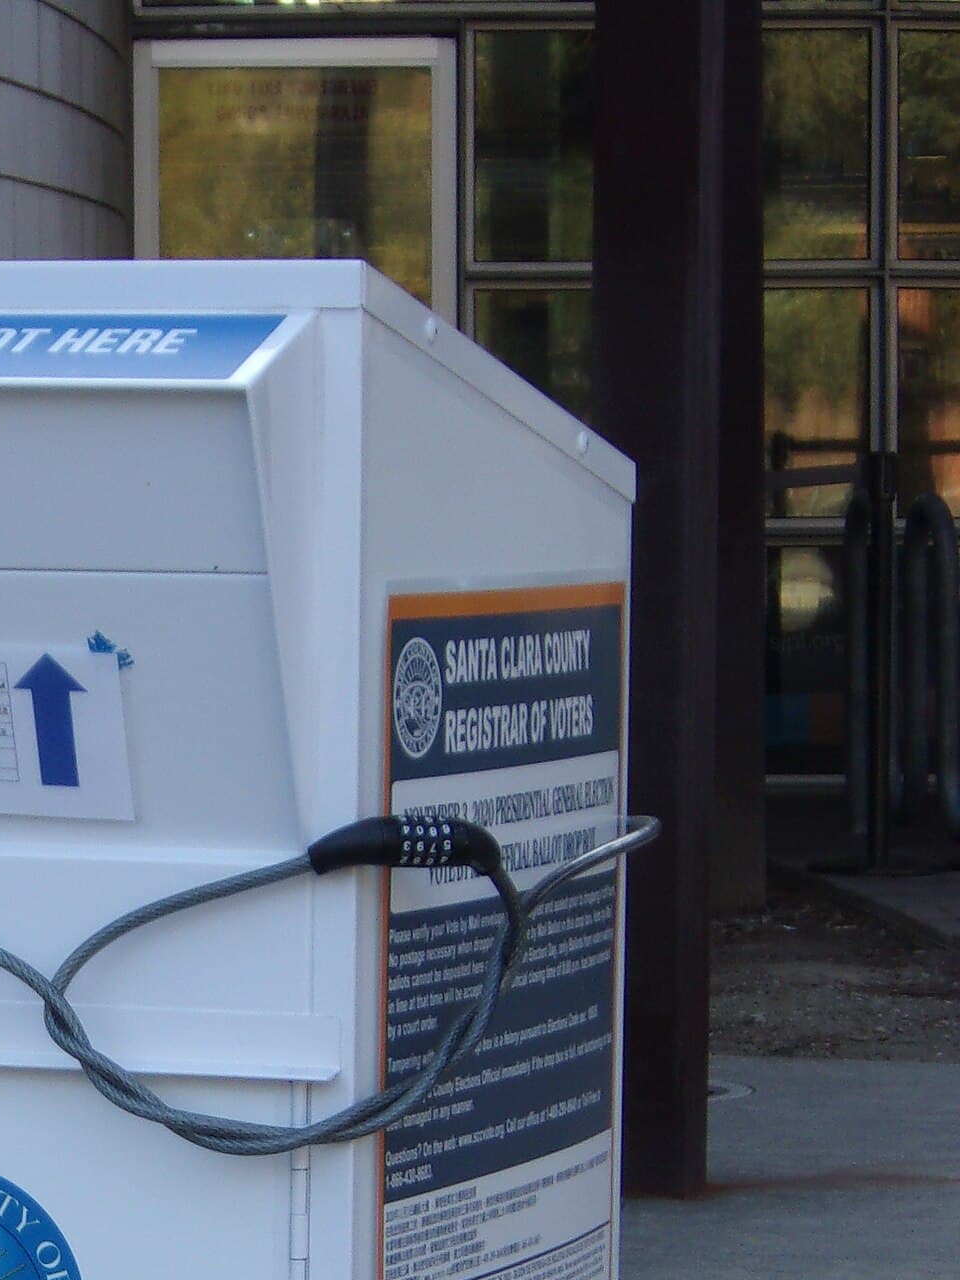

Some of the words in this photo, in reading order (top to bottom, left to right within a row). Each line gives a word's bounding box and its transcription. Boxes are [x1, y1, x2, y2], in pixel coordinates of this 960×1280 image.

[48, 328, 198, 355] HERE
[445, 638, 498, 684] SANTA
[501, 633, 541, 679] CLARA
[544, 629, 591, 674] COUNTY
[445, 702, 528, 754] REGISTRAR
[531, 701, 547, 743] OF
[549, 694, 593, 740] VOTERS
[495, 787, 553, 826] PRESIDENTIAL
[533, 833, 562, 869] BALLOT
[389, 929, 410, 943] Please
[446, 920, 458, 933] Vote
[459, 918, 467, 934] by
[389, 953, 398, 966] No
[399, 951, 424, 966] postage
[426, 945, 455, 959] necessary
[388, 976, 409, 990] ballots
[411, 972, 432, 985] cannot
[434, 969, 441, 981] be
[387, 1025, 395, 1039] by
[402, 1020, 419, 1034] court
[388, 1056, 420, 1072] Tampering
[433, 1081, 453, 1096] County
[455, 1075, 480, 1090] Elections
[481, 1068, 499, 1083] Official
[403, 1109, 431, 1126] damaged
[385, 1144, 421, 1165] Questions?
[423, 1142, 432, 1156] On
[432, 1140, 442, 1154] the
